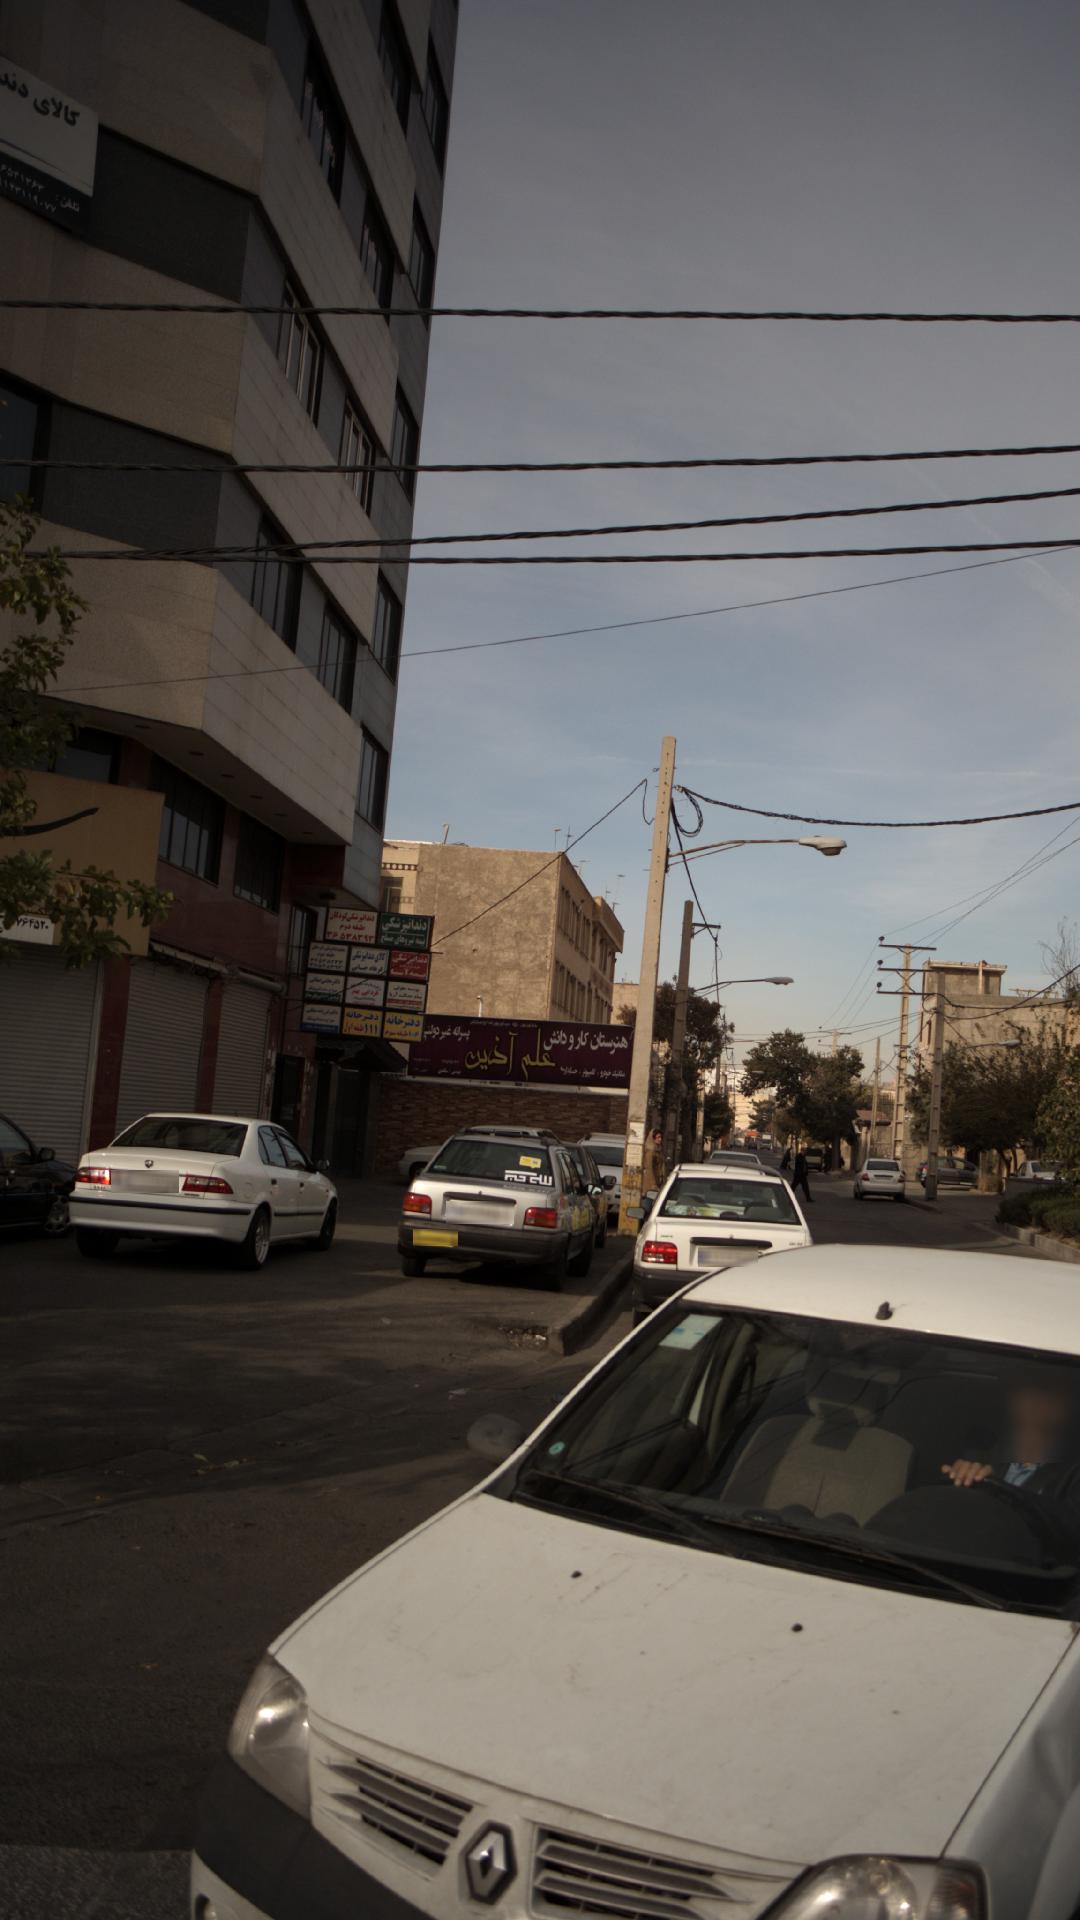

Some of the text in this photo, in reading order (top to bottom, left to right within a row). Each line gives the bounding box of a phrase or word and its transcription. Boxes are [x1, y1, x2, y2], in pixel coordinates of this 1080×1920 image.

[521, 1027, 556, 1081] علم
[543, 1029, 629, 1055] هنرستان کار و دانش
